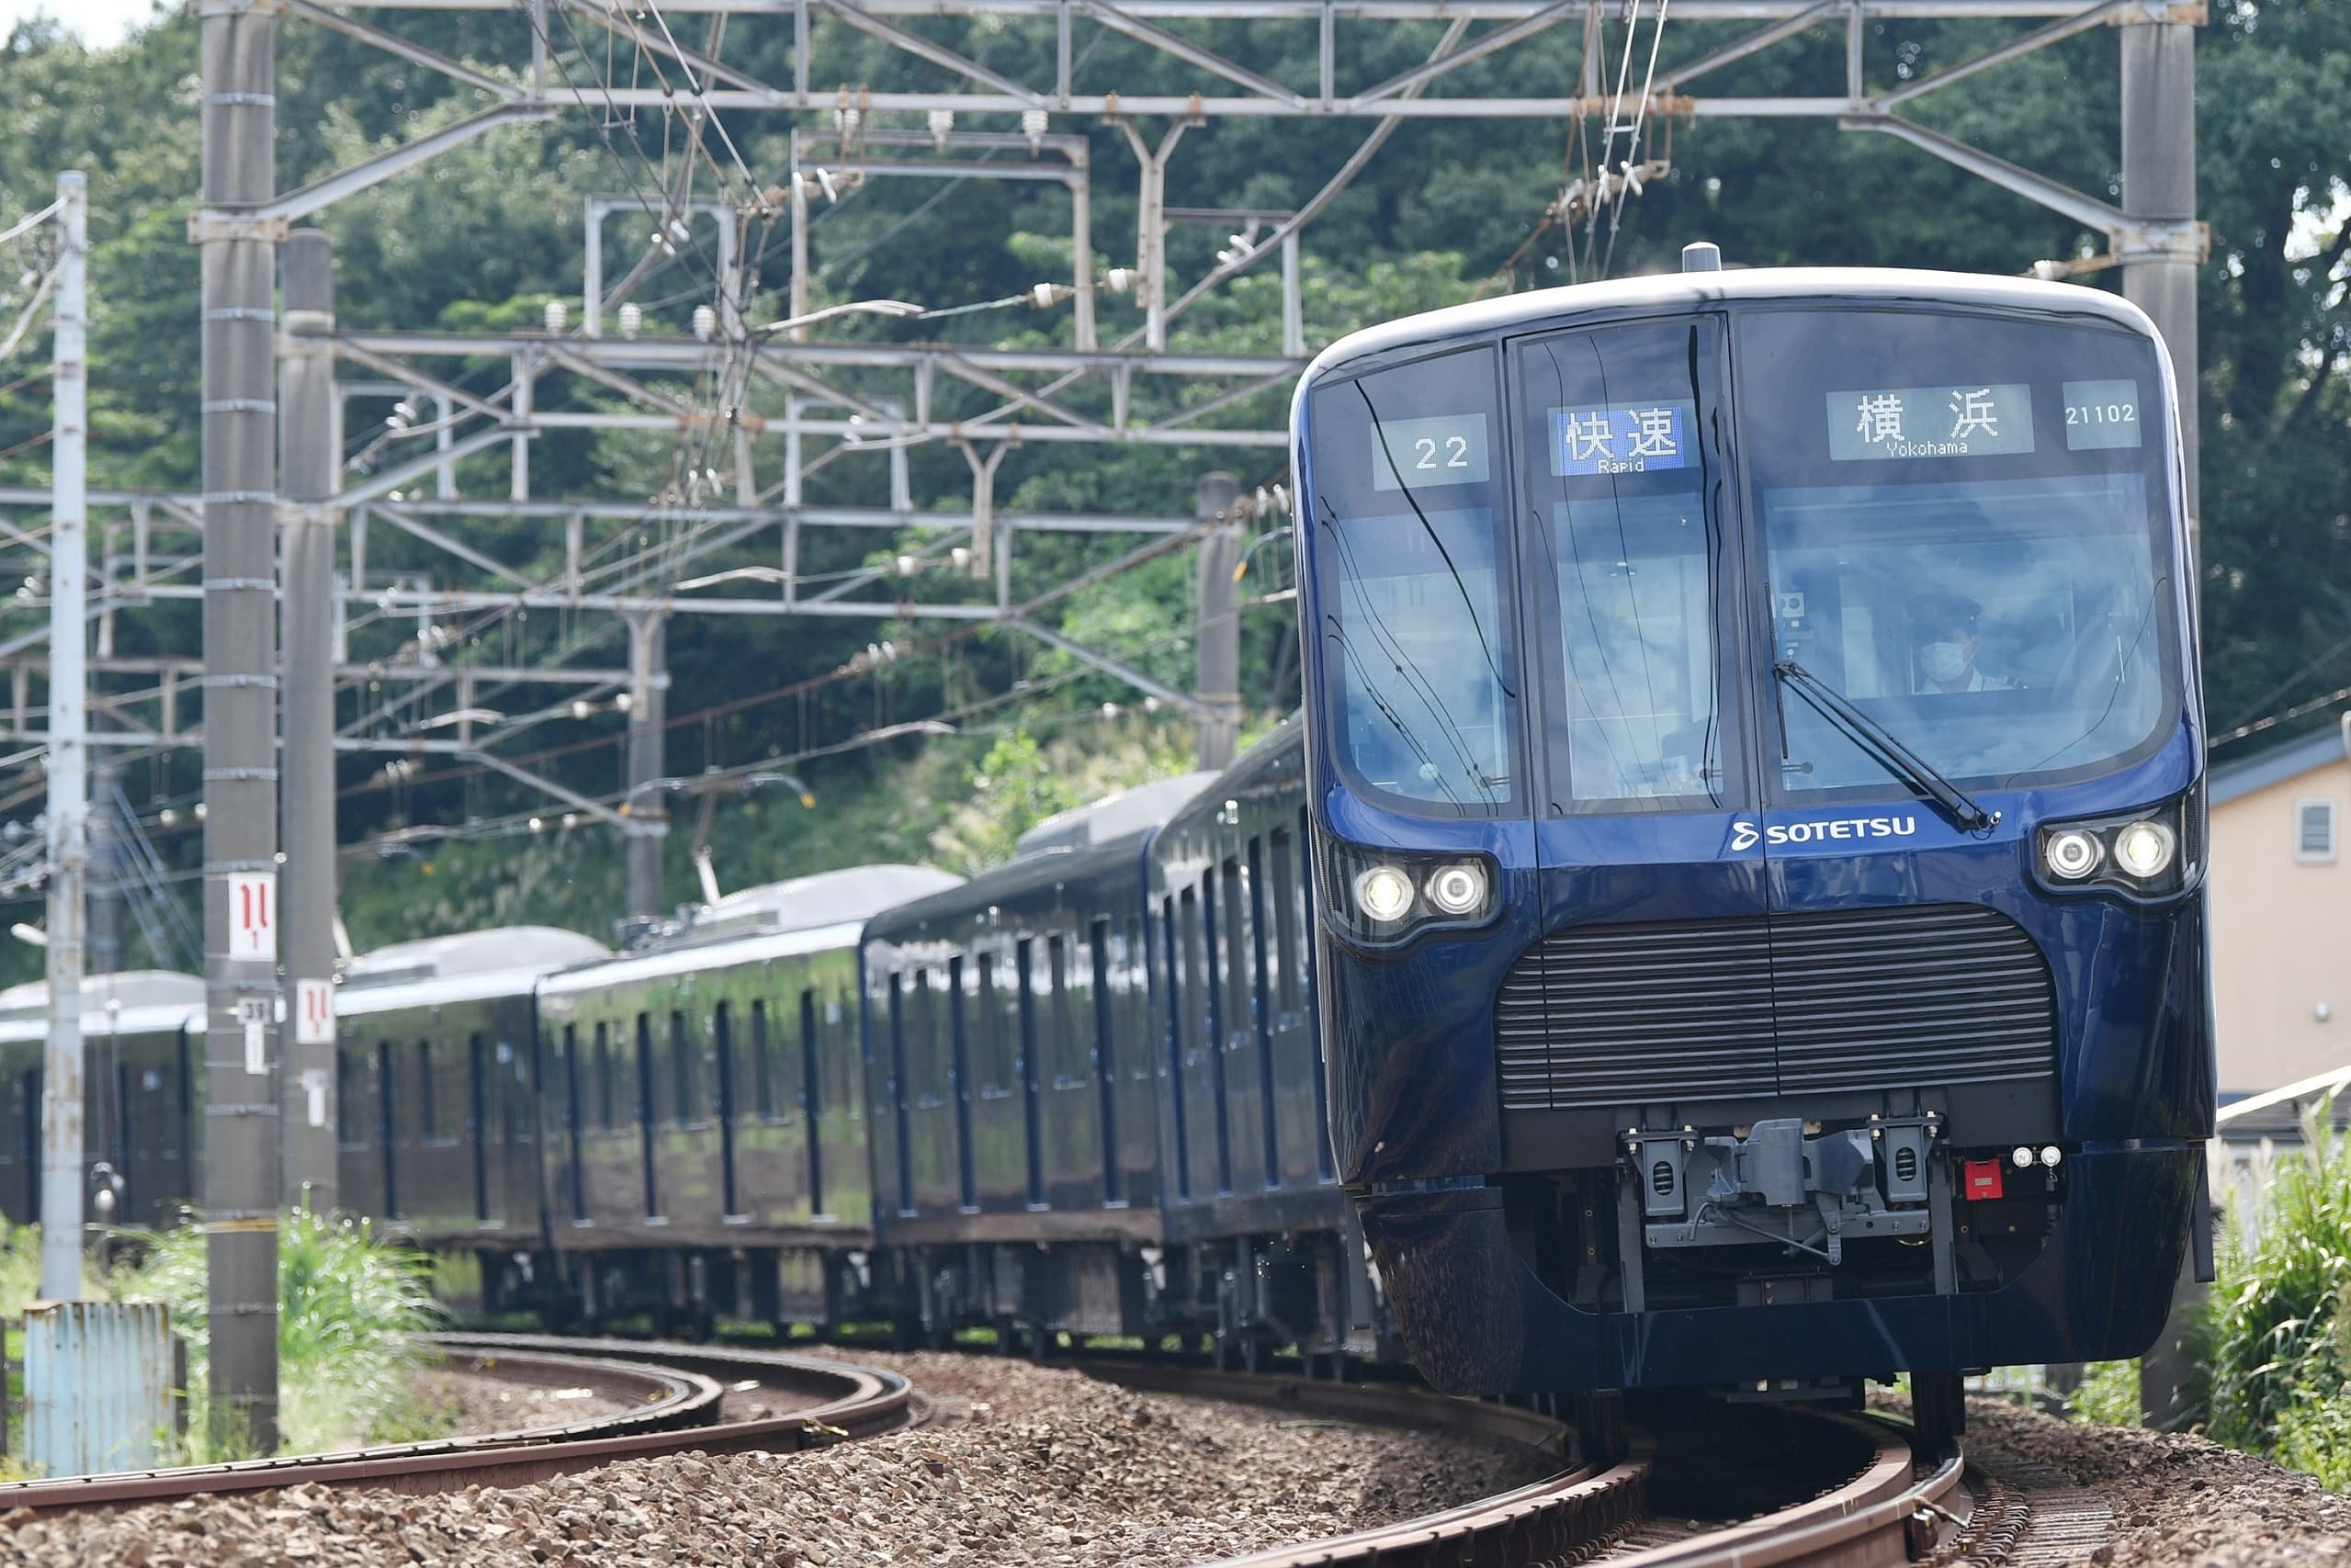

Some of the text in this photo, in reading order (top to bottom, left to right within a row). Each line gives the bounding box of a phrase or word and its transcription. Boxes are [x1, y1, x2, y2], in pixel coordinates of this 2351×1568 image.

[1856, 388, 1999, 444] 横浜
[2064, 404, 2136, 425] 21102
[1565, 407, 1678, 460] 快速
[1886, 440, 1968, 457] Yokohama
[1415, 435, 1469, 469] 22
[1766, 816, 1916, 845] SOTETSU
